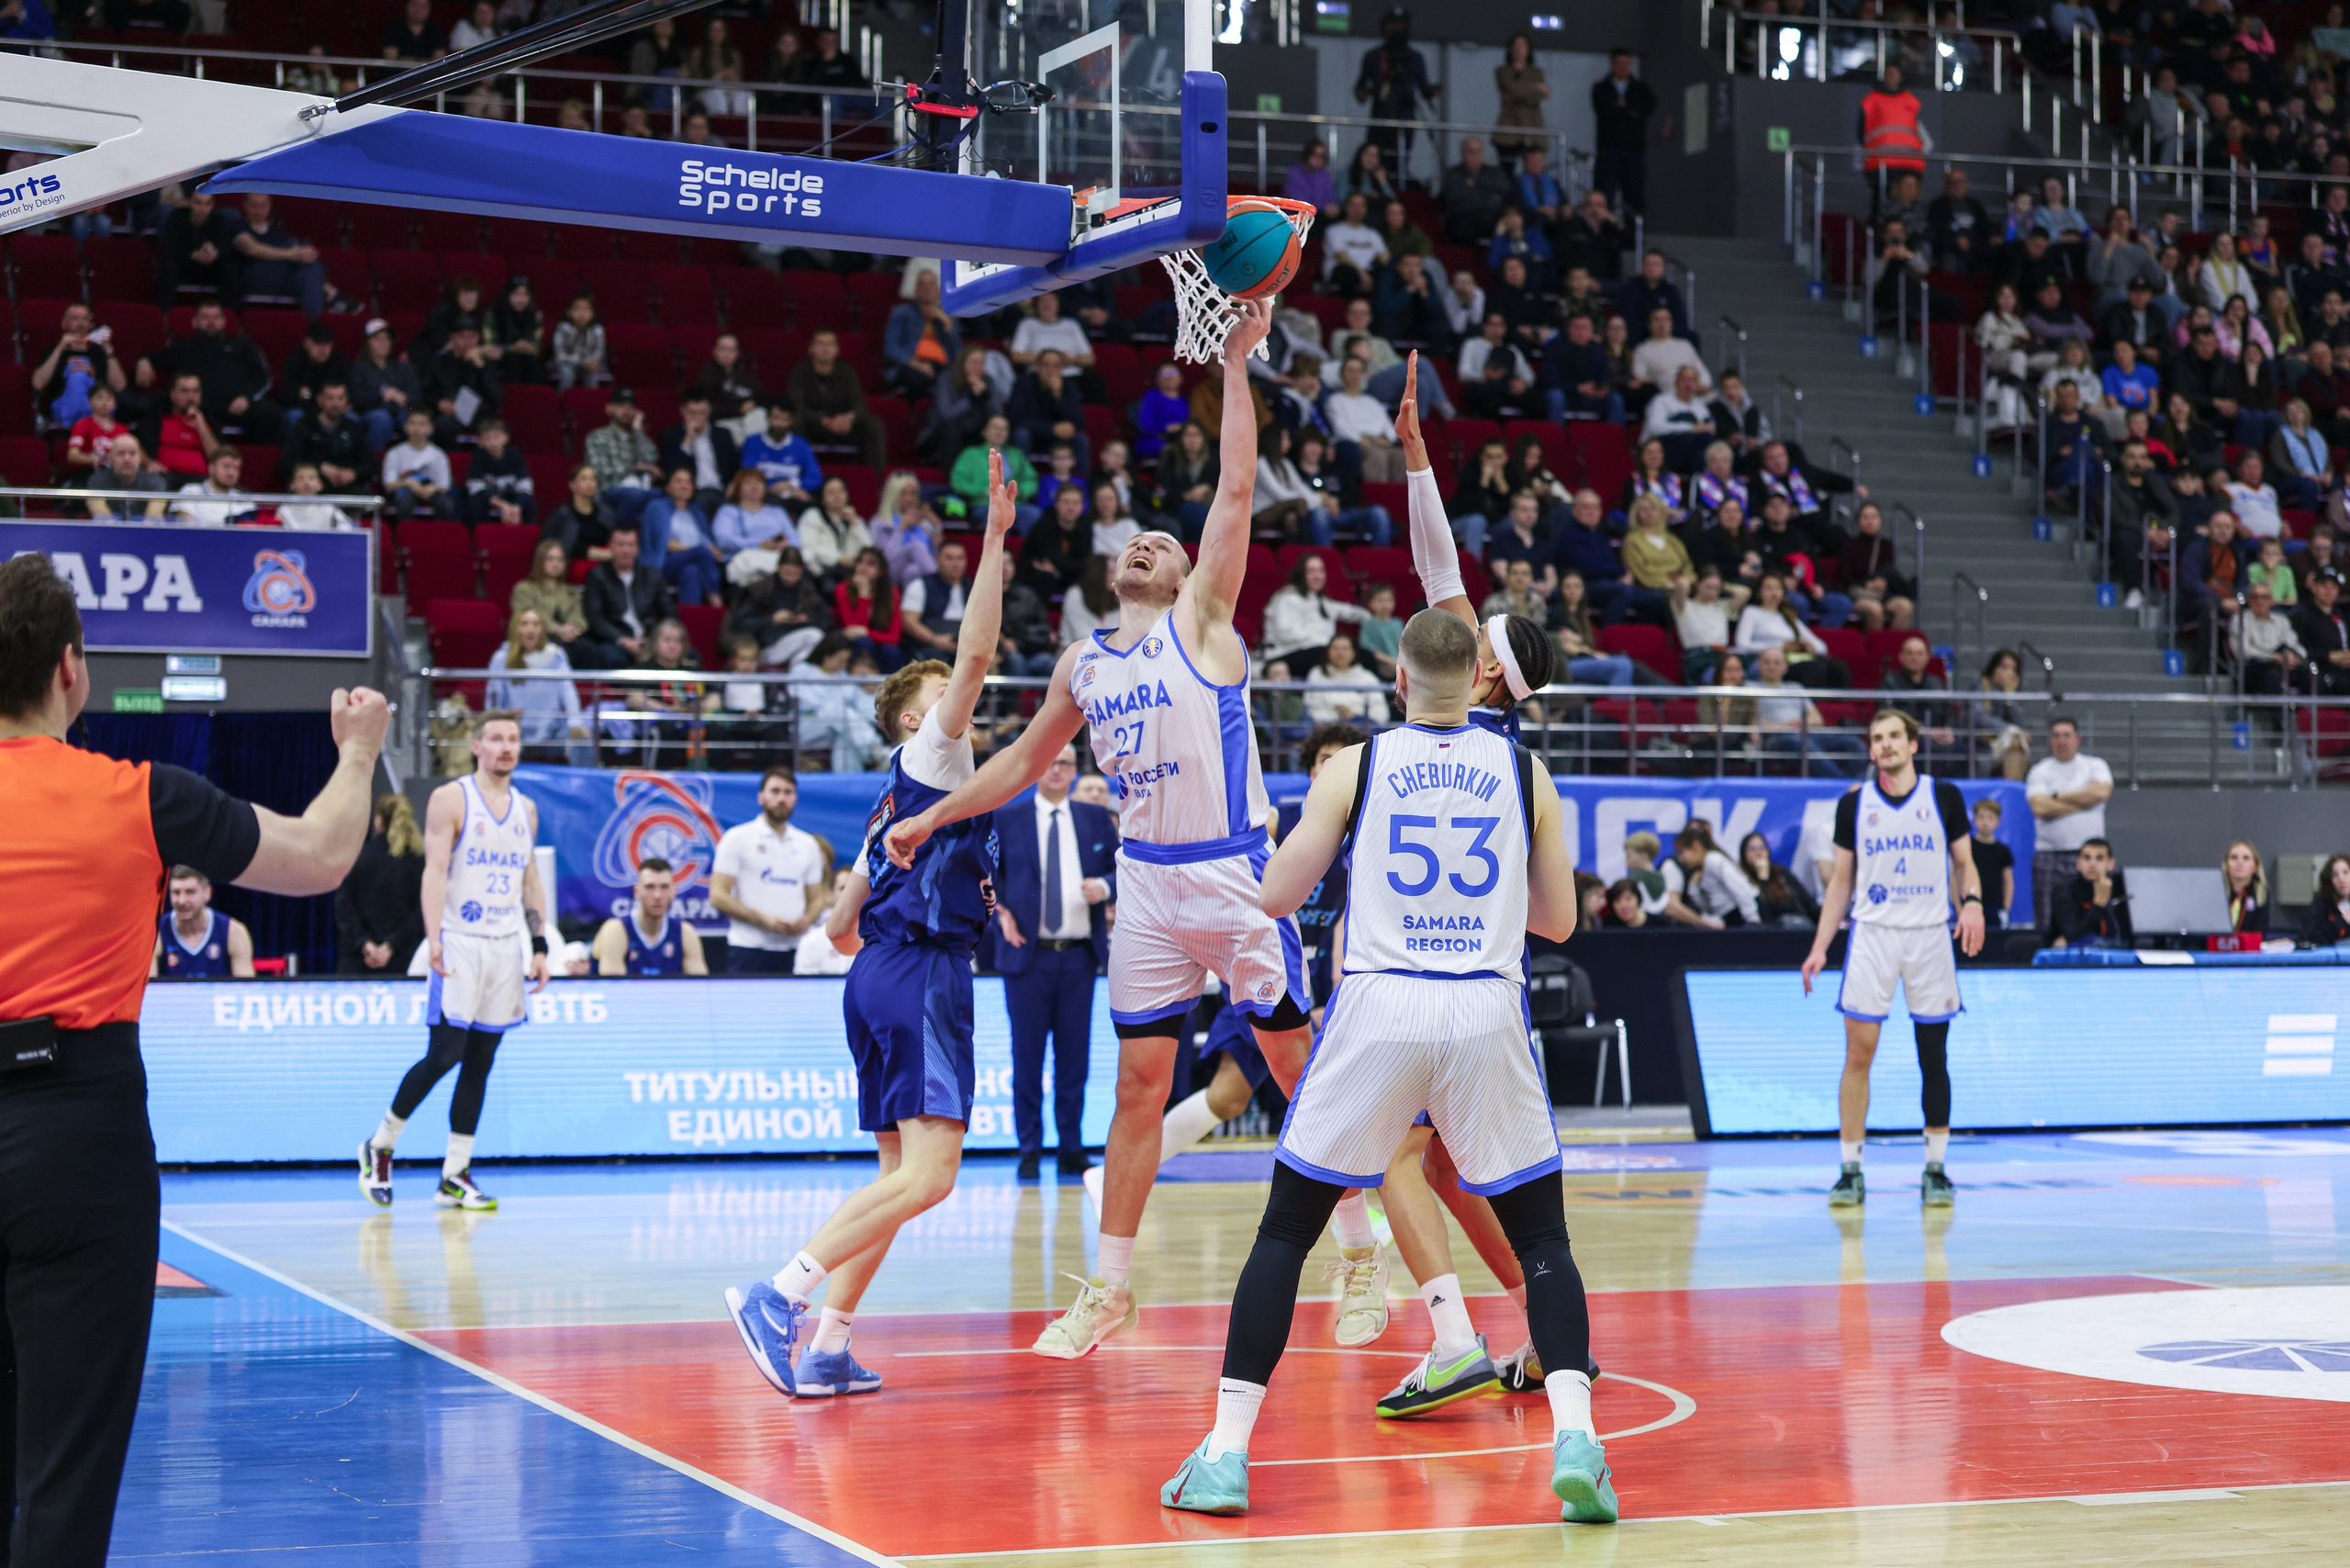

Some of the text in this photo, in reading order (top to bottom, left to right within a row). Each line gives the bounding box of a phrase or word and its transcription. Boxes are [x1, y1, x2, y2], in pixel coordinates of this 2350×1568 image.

[680, 160, 824, 195] Schelde
[22, 202, 34, 212] by
[35, 194, 66, 208] Design
[678, 183, 822, 218] Sports
[251, 613, 308, 629] САМАРА
[115, 694, 163, 714] ВЫХОД
[1085, 678, 1173, 728] SAMARA
[1113, 721, 1145, 757] 27
[1387, 762, 1502, 803] CHEBURKIN
[1386, 813, 1501, 898] 53
[1864, 834, 1935, 857] SAMARA
[1894, 856, 1907, 877] 4
[486, 872, 510, 896] 23
[1403, 914, 1485, 931] SAMARA
[1405, 937, 1482, 952] REGION
[213, 987, 397, 1032] ЕДИНОЙ
[530, 992, 608, 1024] ВТБ
[624, 1070, 857, 1104] ТИТУЛЬНЫ
[667, 1101, 844, 1147] ЕДИНОЙ
[971, 1103, 1014, 1137] ВТ
